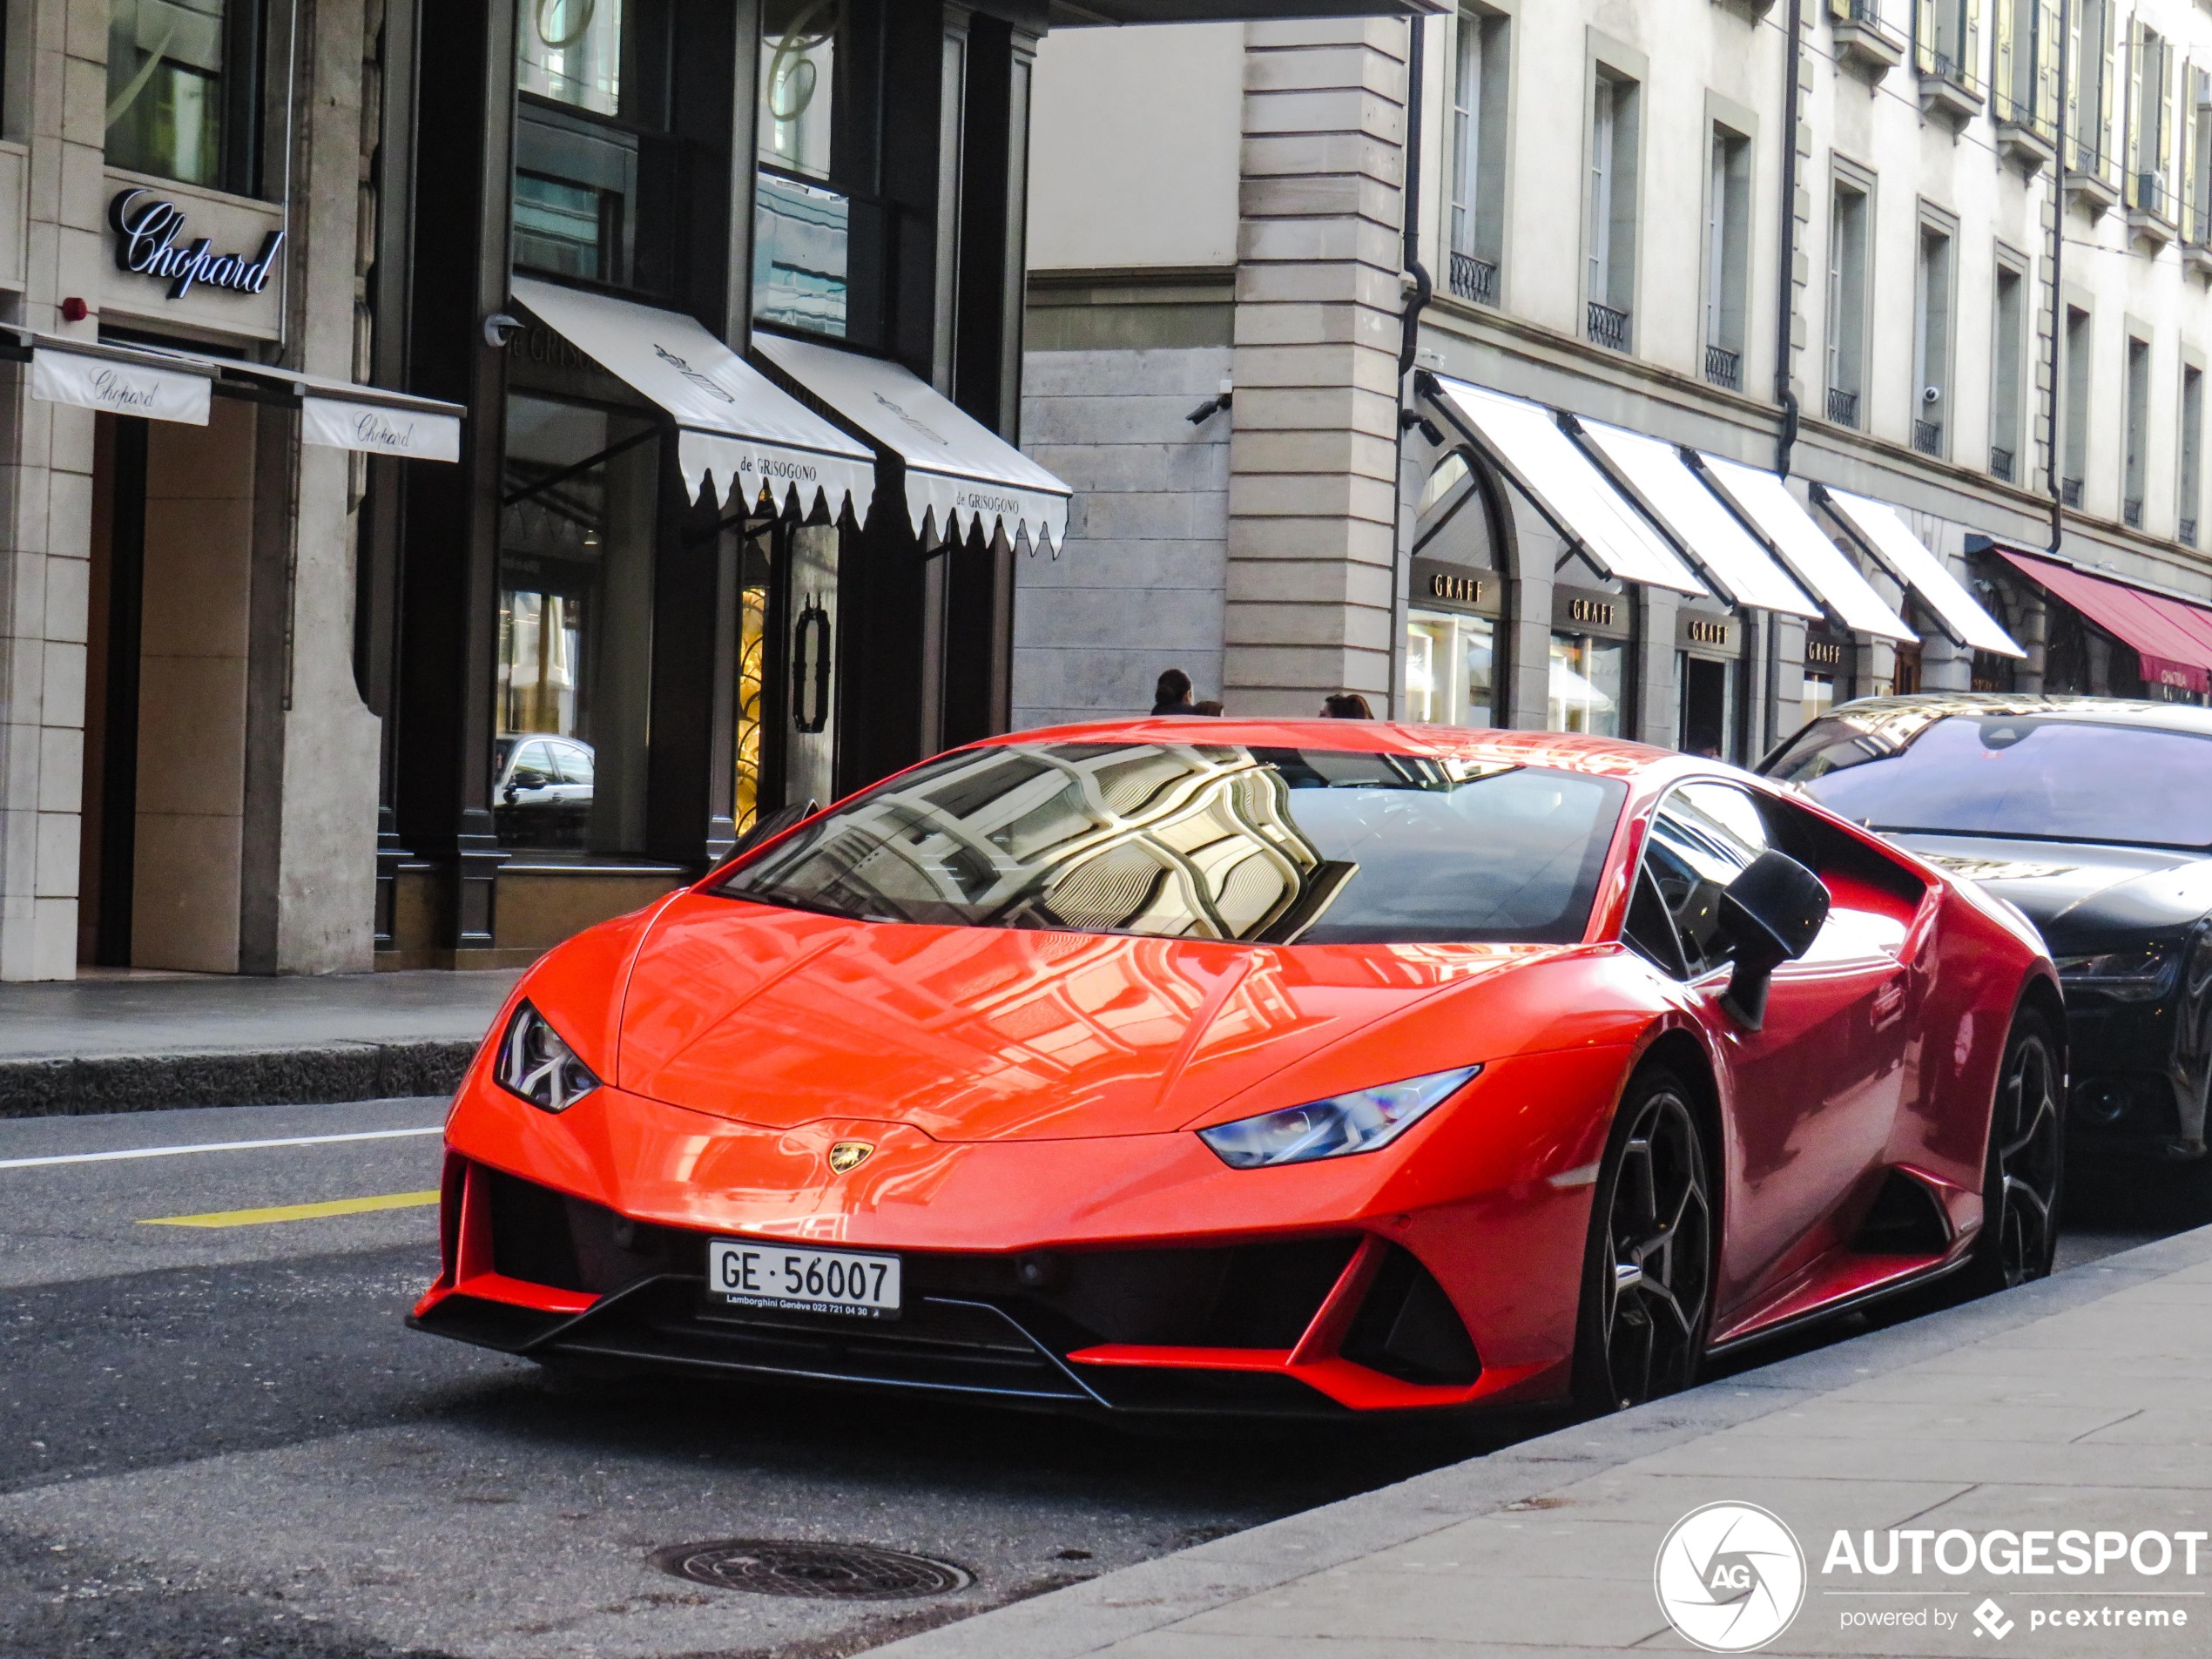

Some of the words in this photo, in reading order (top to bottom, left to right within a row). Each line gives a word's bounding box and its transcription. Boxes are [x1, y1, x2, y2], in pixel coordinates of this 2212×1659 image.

[110, 188, 285, 300] Chopard
[91, 368, 158, 408] Chopard
[353, 412, 414, 448] Chopard
[740, 455, 752, 472] de
[757, 458, 817, 482] GRISOGONO
[956, 491, 965, 506] de
[968, 493, 1019, 515] GRISOGONO
[1433, 573, 1483, 603] GRAFF
[1573, 598, 1615, 625] GRAFF
[1692, 620, 1729, 644] GRAFF
[1809, 641, 1840, 664] GRAFF
[726, 1294, 778, 1307] Lamborghini
[813, 1303, 827, 1312] 022
[829, 1305, 843, 1313] 721
[846, 1305, 855, 1315] 04
[858, 1307, 867, 1316] 30
